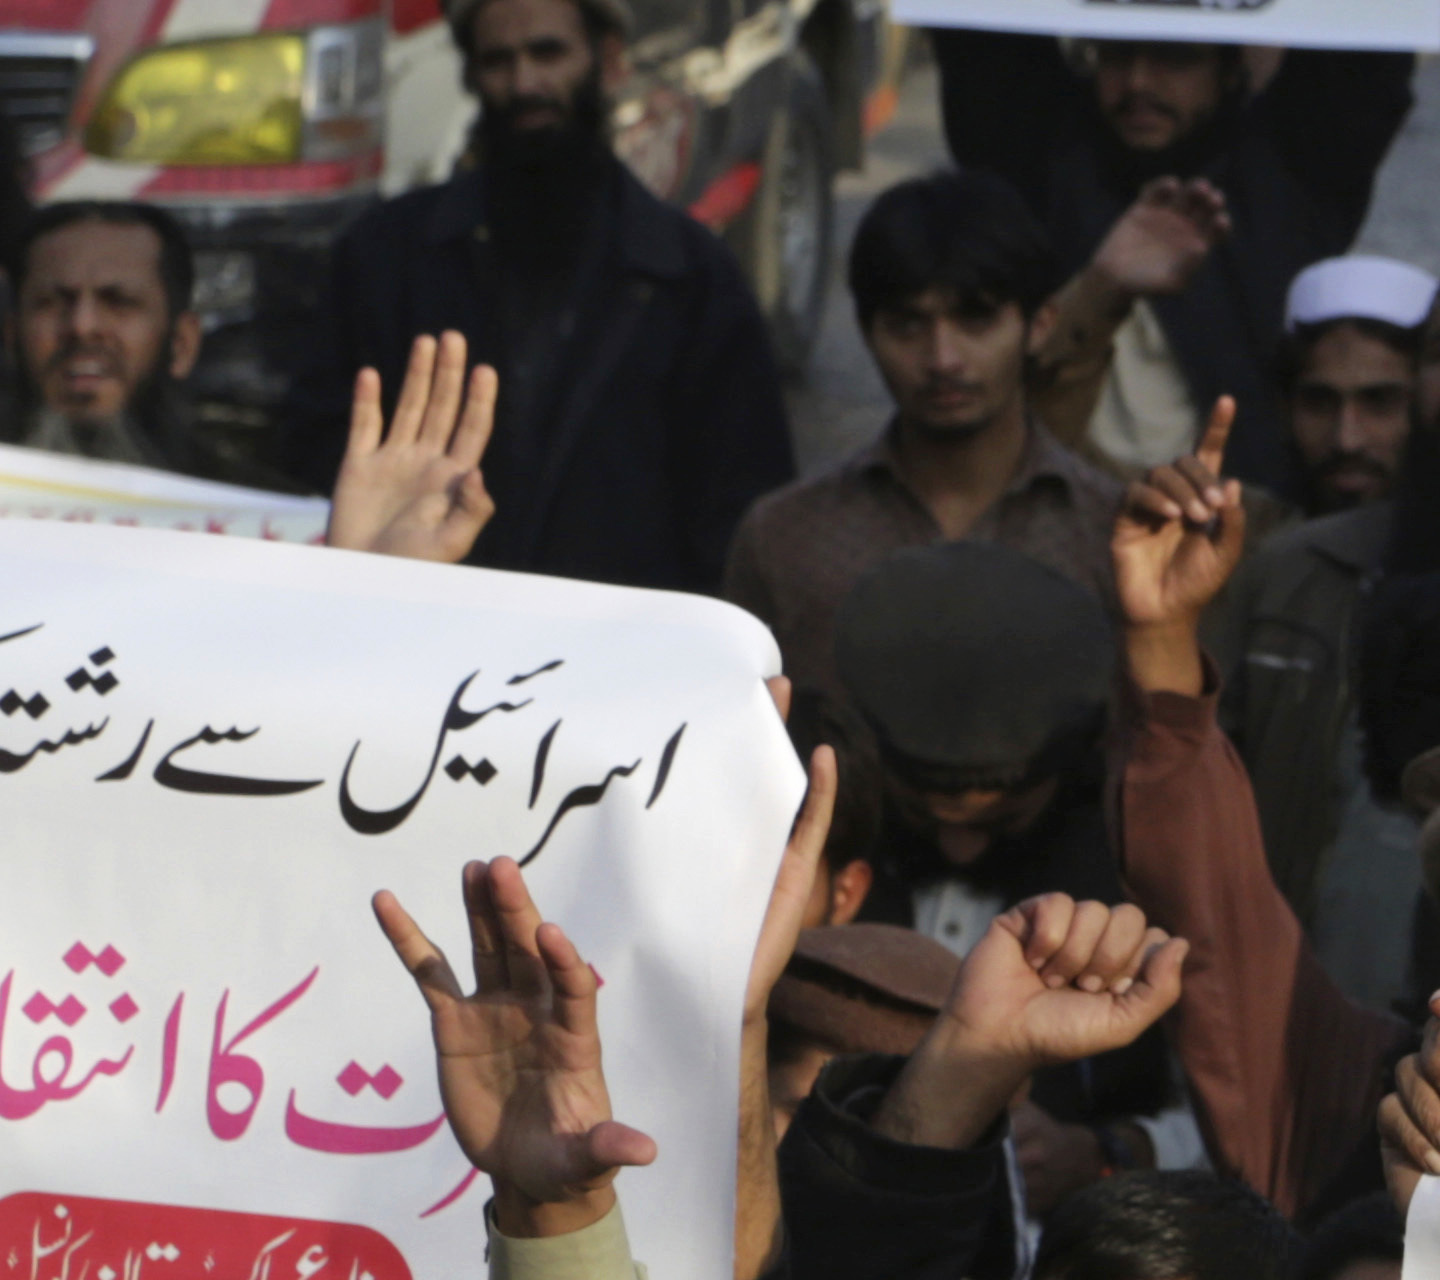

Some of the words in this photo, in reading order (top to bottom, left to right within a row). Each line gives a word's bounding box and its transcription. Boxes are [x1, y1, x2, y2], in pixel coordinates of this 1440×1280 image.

[151, 718, 328, 798] سے
[338, 657, 690, 870] اسرائیل
[204, 964, 323, 1143] کا
